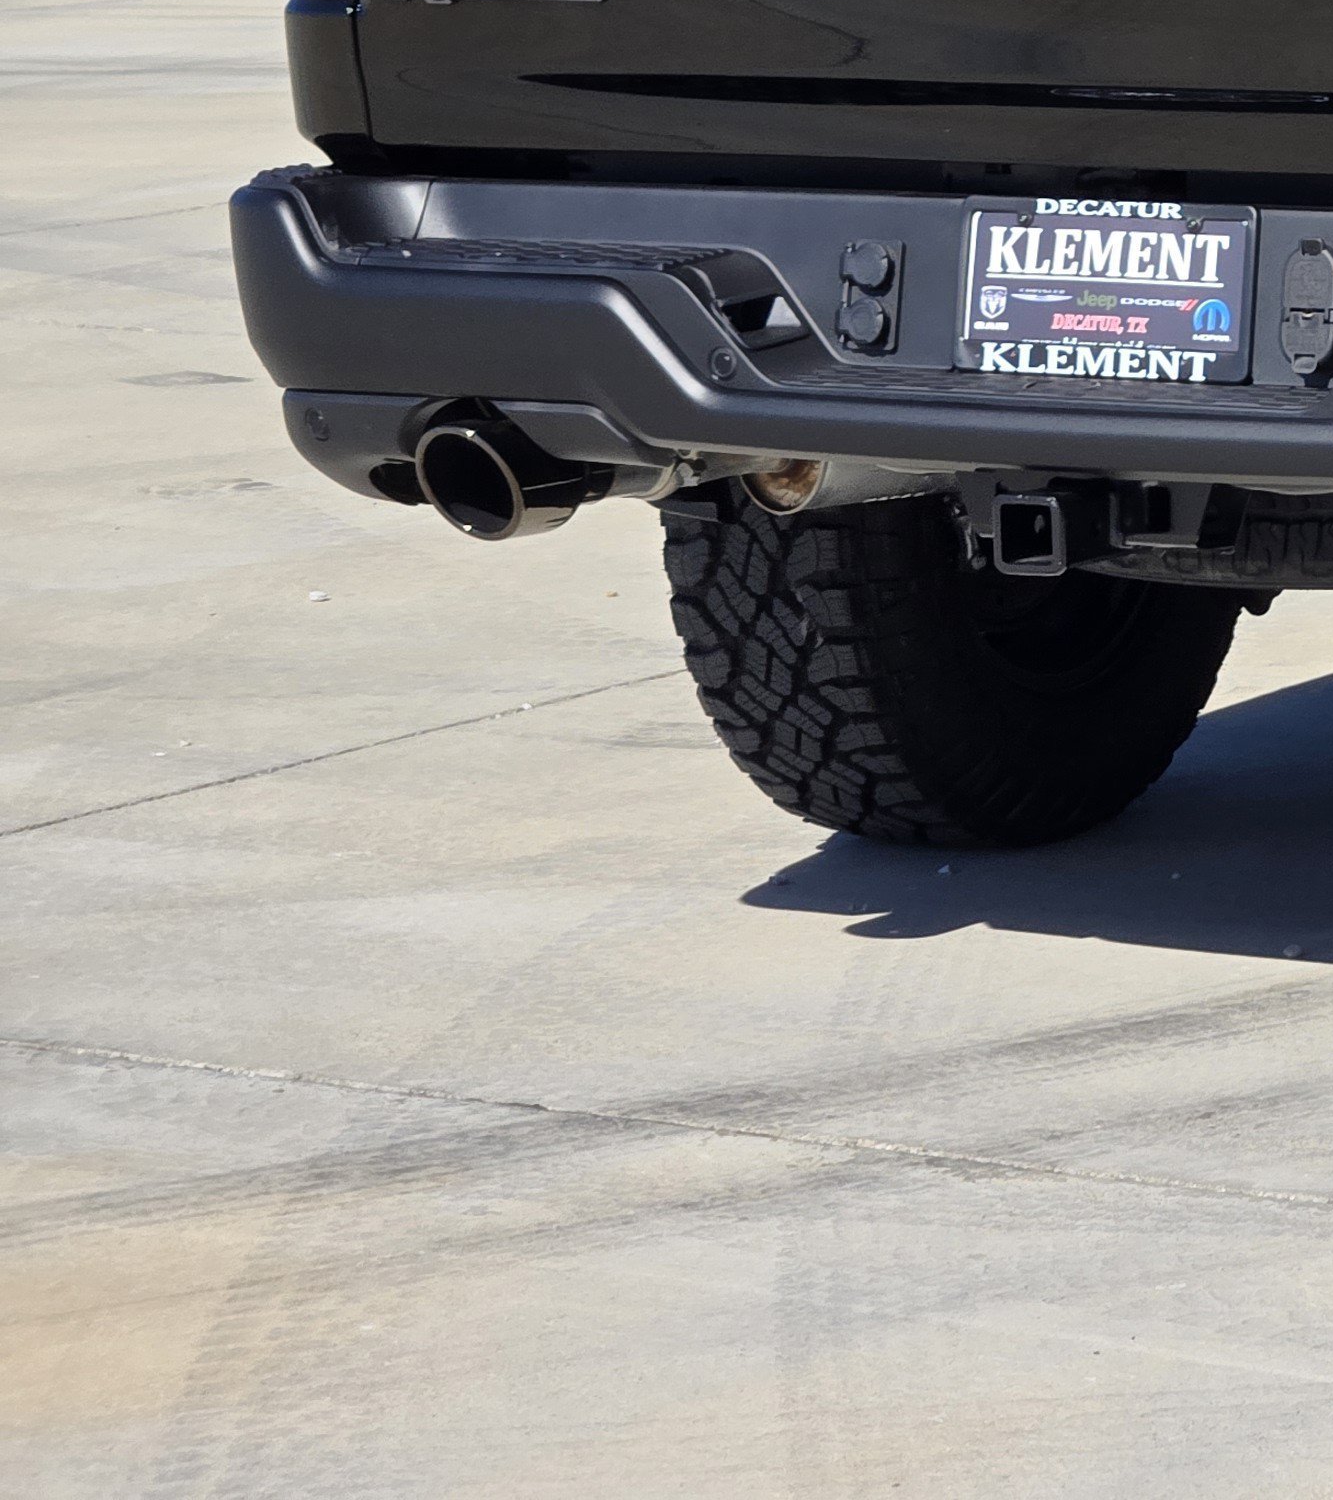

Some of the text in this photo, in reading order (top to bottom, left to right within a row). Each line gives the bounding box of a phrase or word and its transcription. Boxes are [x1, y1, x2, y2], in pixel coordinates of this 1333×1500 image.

[1035, 197, 1184, 220] DECATUR
[986, 225, 1231, 283] KLEMENT
[1076, 289, 1118, 310] Jeep
[1120, 296, 1190, 308] DODGE
[1050, 312, 1150, 336] DECATUR, TX
[979, 341, 1217, 383] KLEMENT
